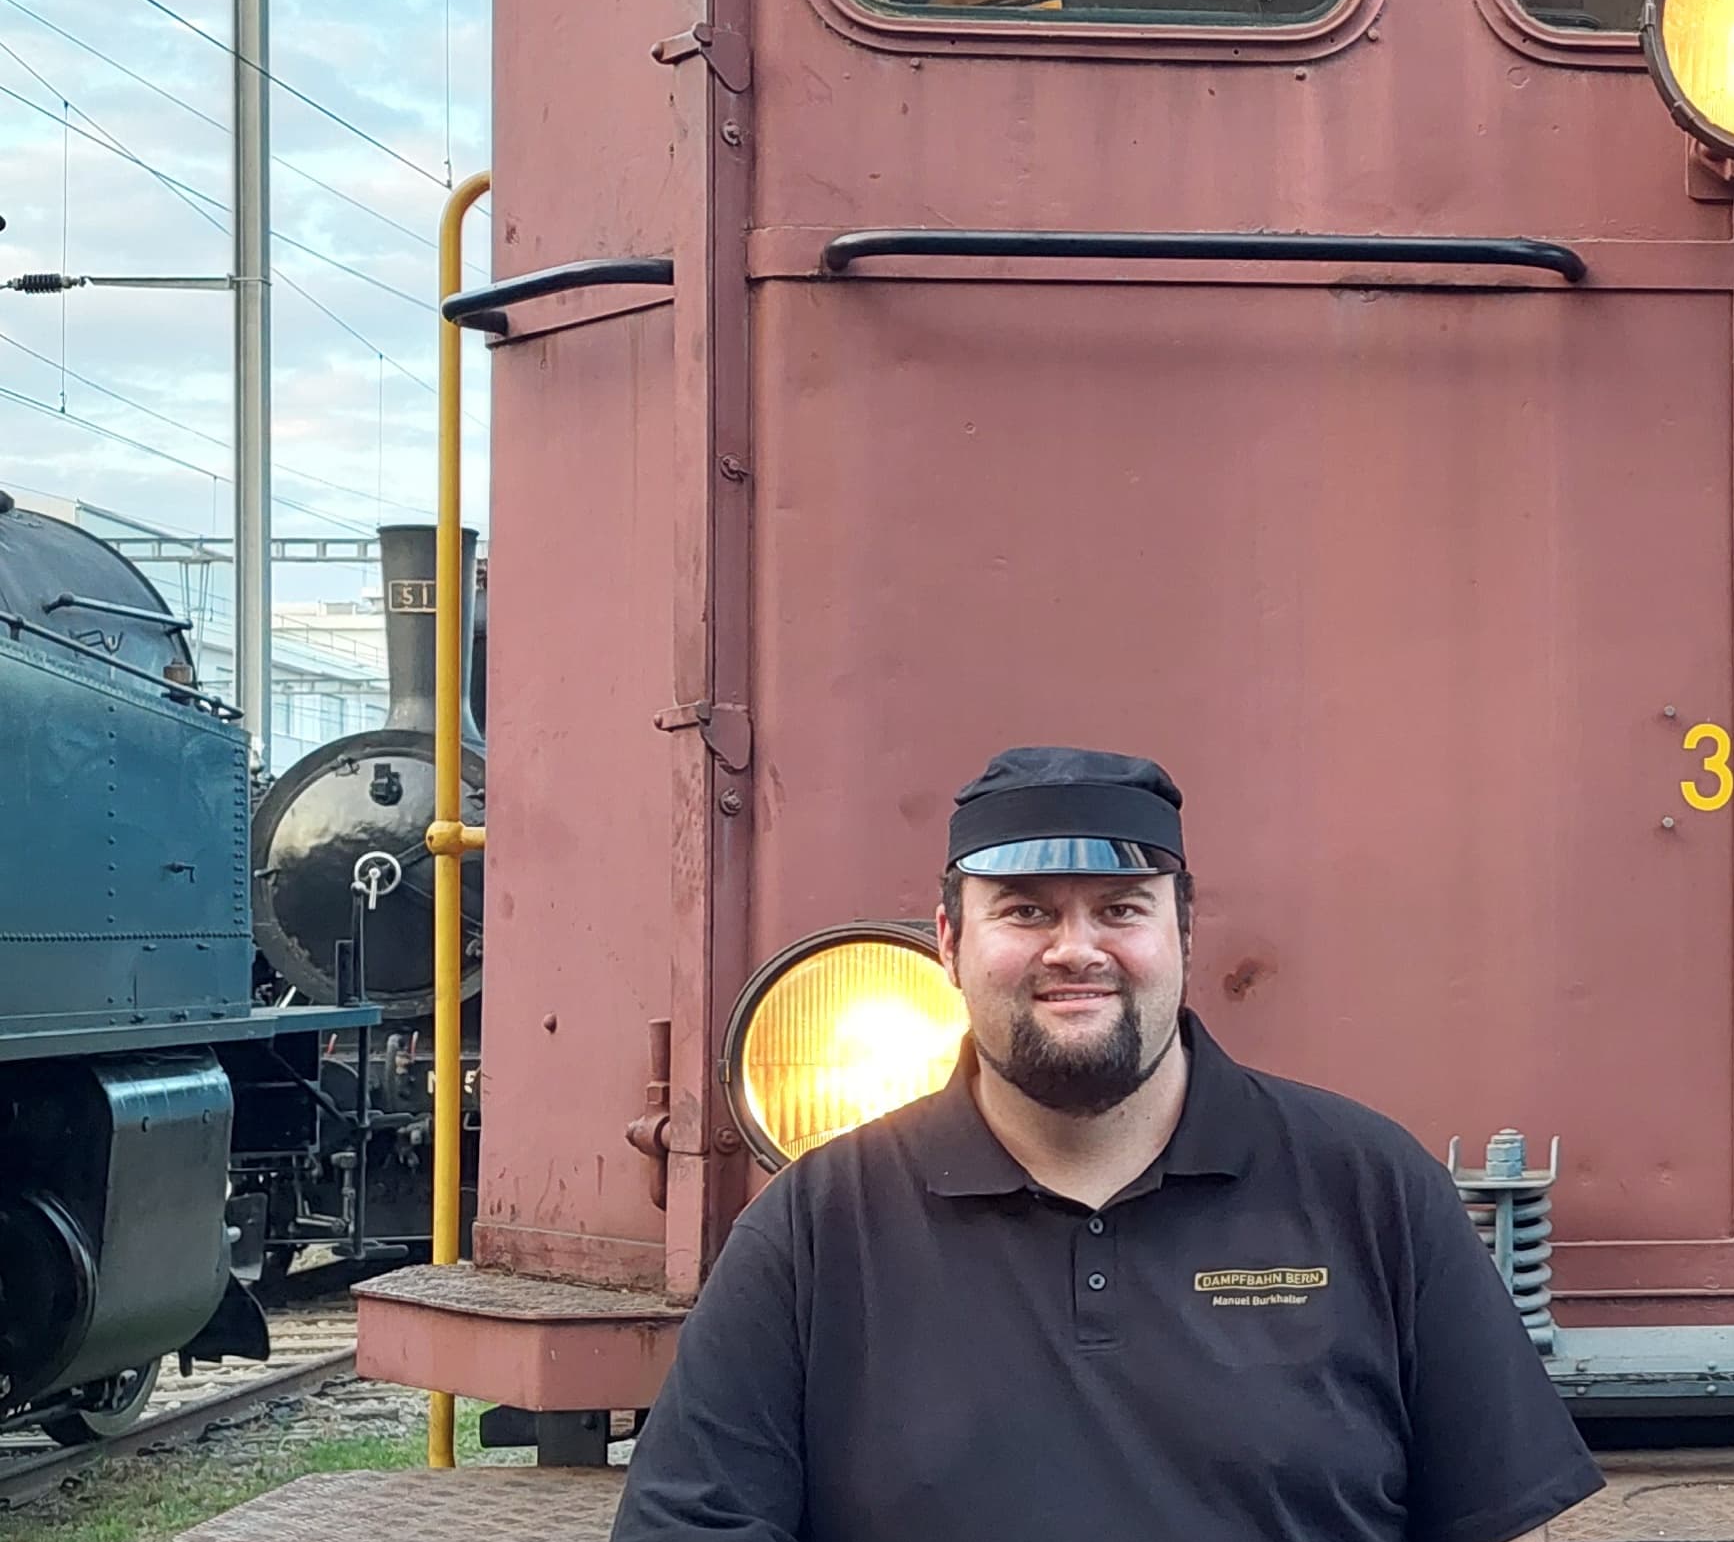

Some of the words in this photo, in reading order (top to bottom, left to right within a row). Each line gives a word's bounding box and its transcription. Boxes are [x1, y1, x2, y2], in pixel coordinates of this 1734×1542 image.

[1202, 1272, 1282, 1288] DAMPFBAHN
[1285, 1272, 1320, 1285] BERN
[1212, 1295, 1250, 1307] Manuel
